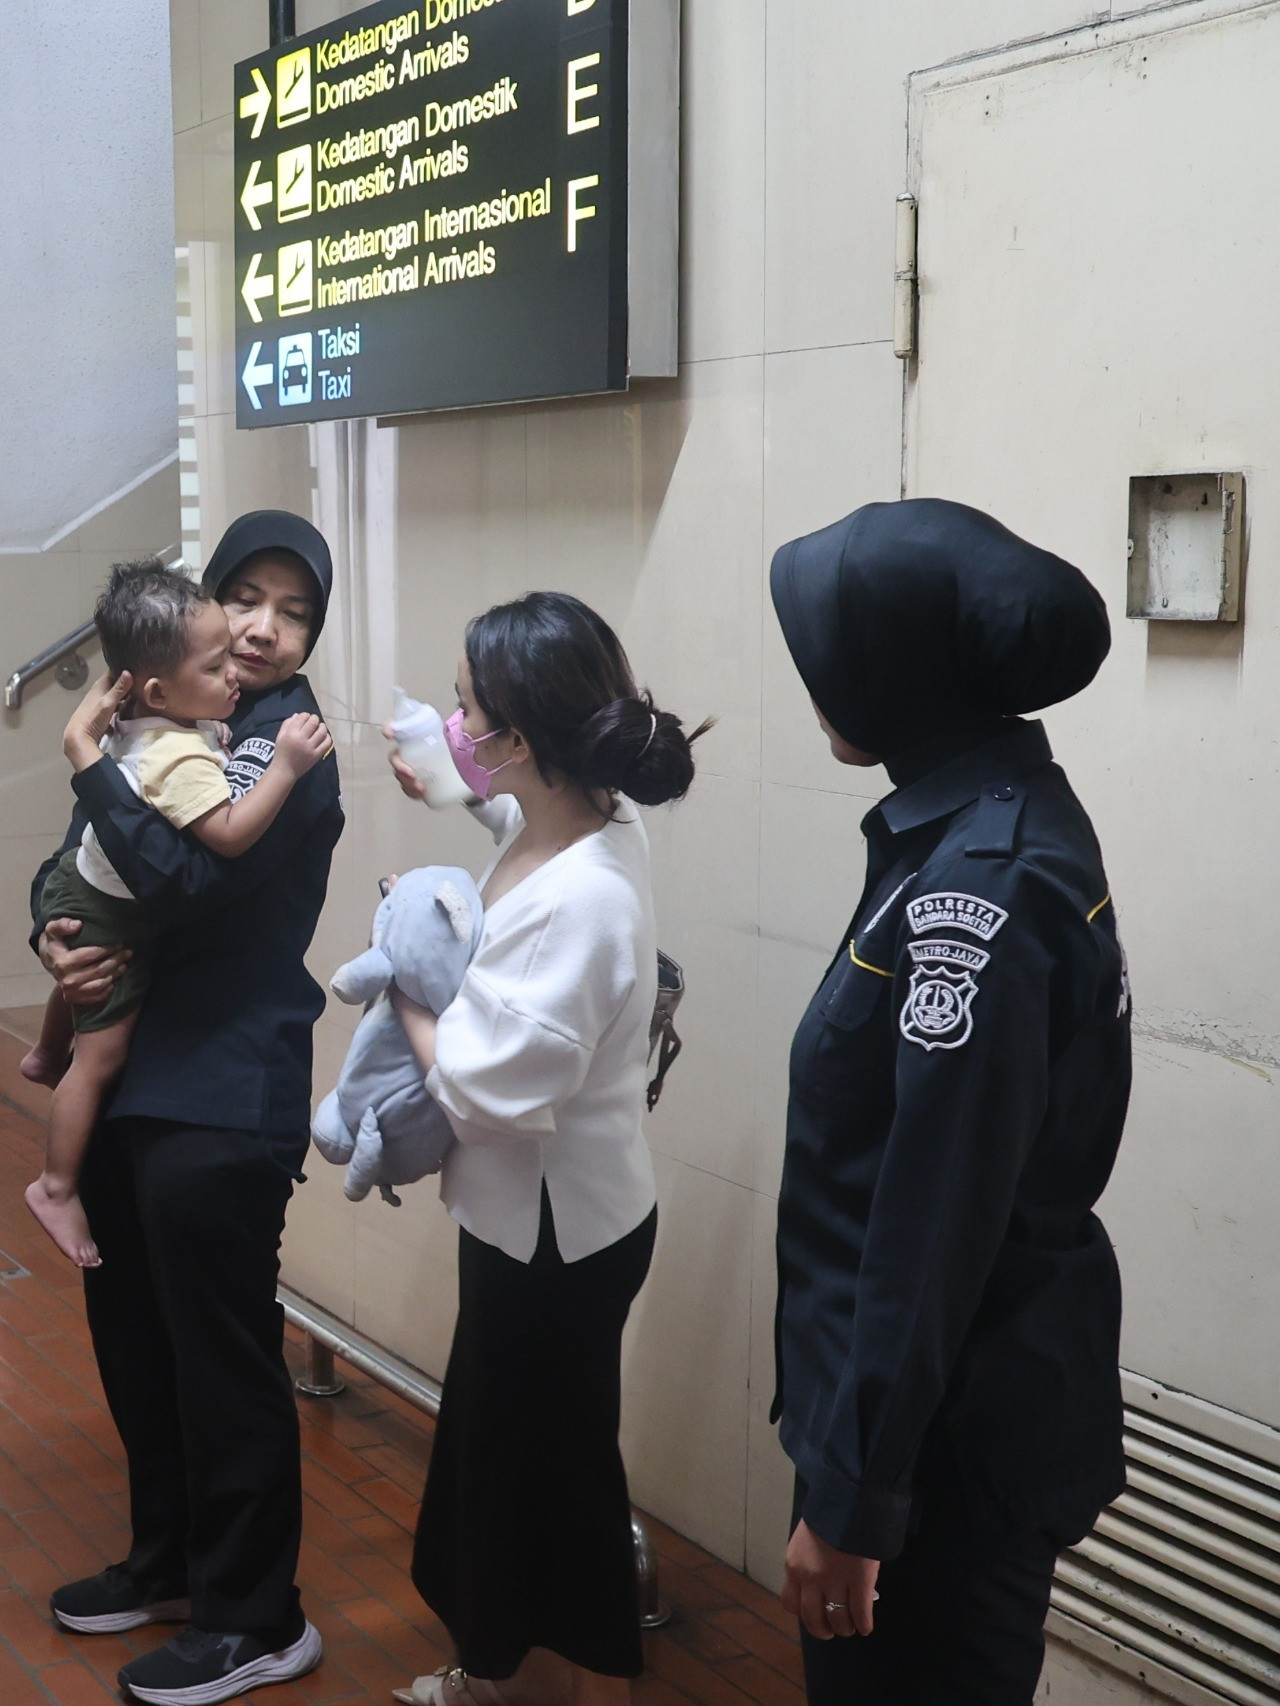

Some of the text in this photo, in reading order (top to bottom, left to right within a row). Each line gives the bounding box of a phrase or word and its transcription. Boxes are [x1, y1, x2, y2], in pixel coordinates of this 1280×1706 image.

[317, 11, 419, 73] Kedatangan
[317, 31, 469, 115] Domestic Arrivals
[317, 52, 600, 171] Kedatangan Domestik E
[317, 140, 469, 212] Domestic Arrivals
[317, 174, 599, 268] Kedatangan Internasional F
[317, 241, 496, 308] International Arrivals
[318, 323, 360, 360] Taksi
[318, 367, 351, 400] Taxi
[914, 898, 995, 924] POLRESTA
[914, 910, 991, 934] BANDARA SOETTA
